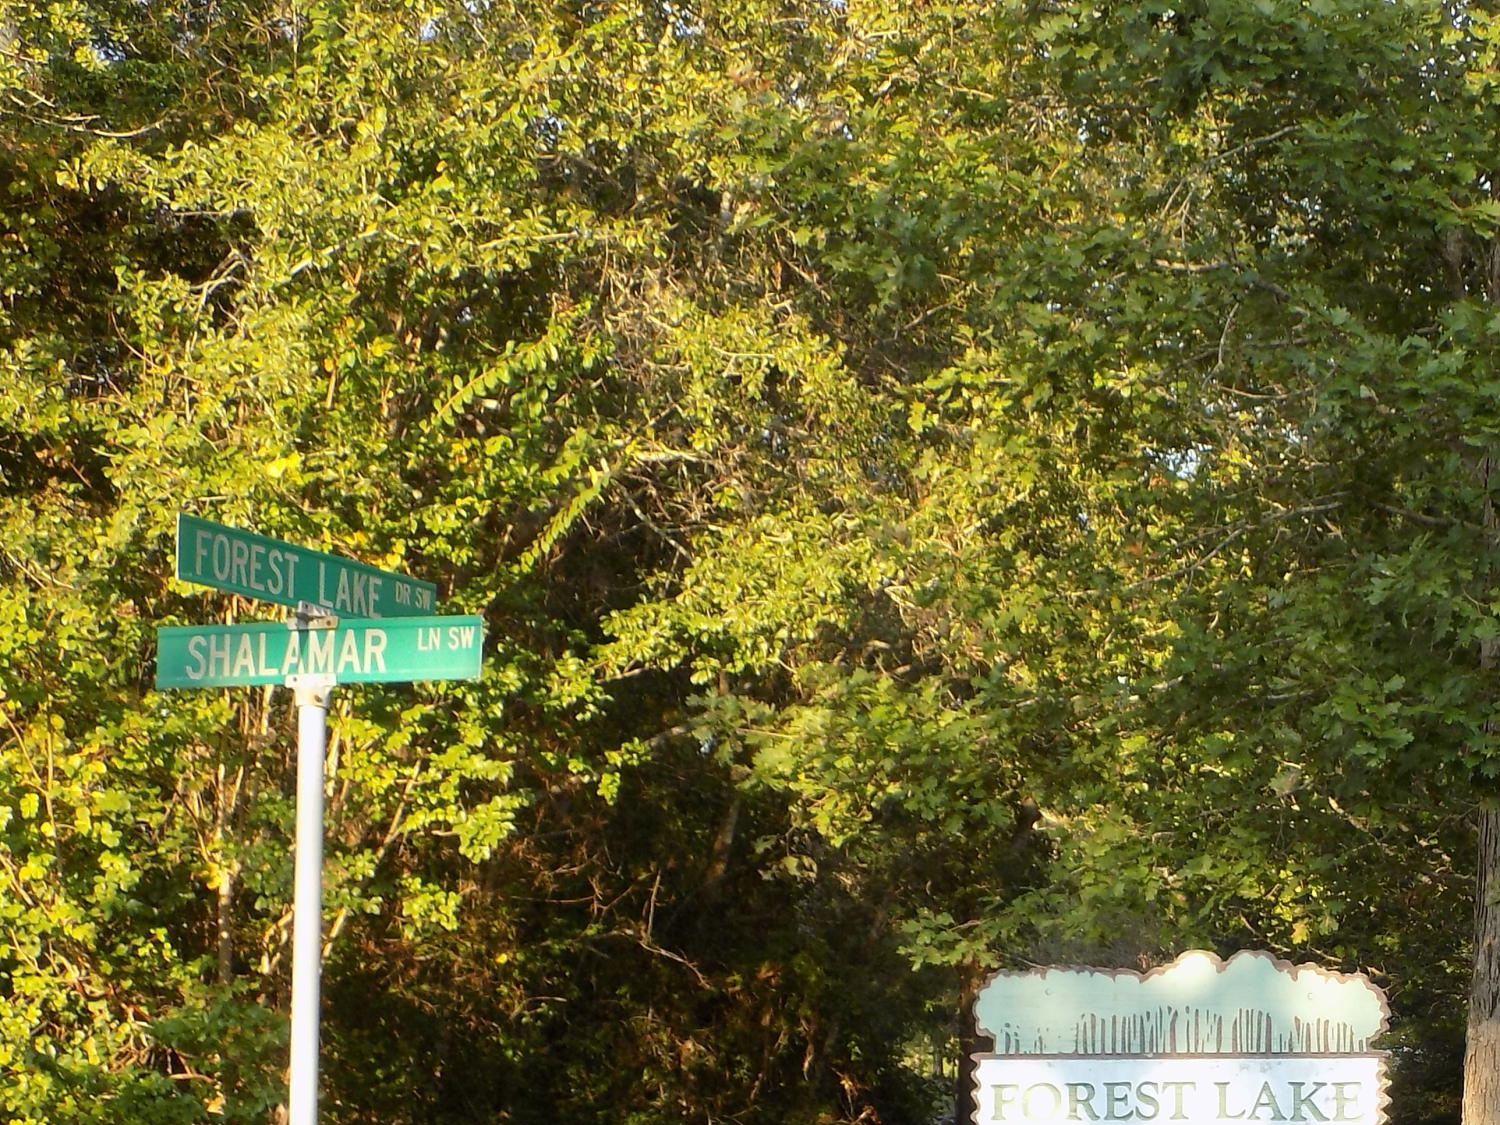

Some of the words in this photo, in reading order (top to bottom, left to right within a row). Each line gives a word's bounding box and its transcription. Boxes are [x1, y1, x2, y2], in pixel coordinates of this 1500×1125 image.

[195, 531, 299, 598] FOREST
[319, 562, 383, 618] LAKE
[395, 581, 411, 606] DR
[415, 586, 432, 611] SW
[185, 629, 387, 680] SHALAMAR
[418, 627, 441, 650] LN
[448, 626, 475, 650] SW
[990, 1081, 1197, 1122] FOREST
[1213, 1080, 1365, 1122] LAKE
